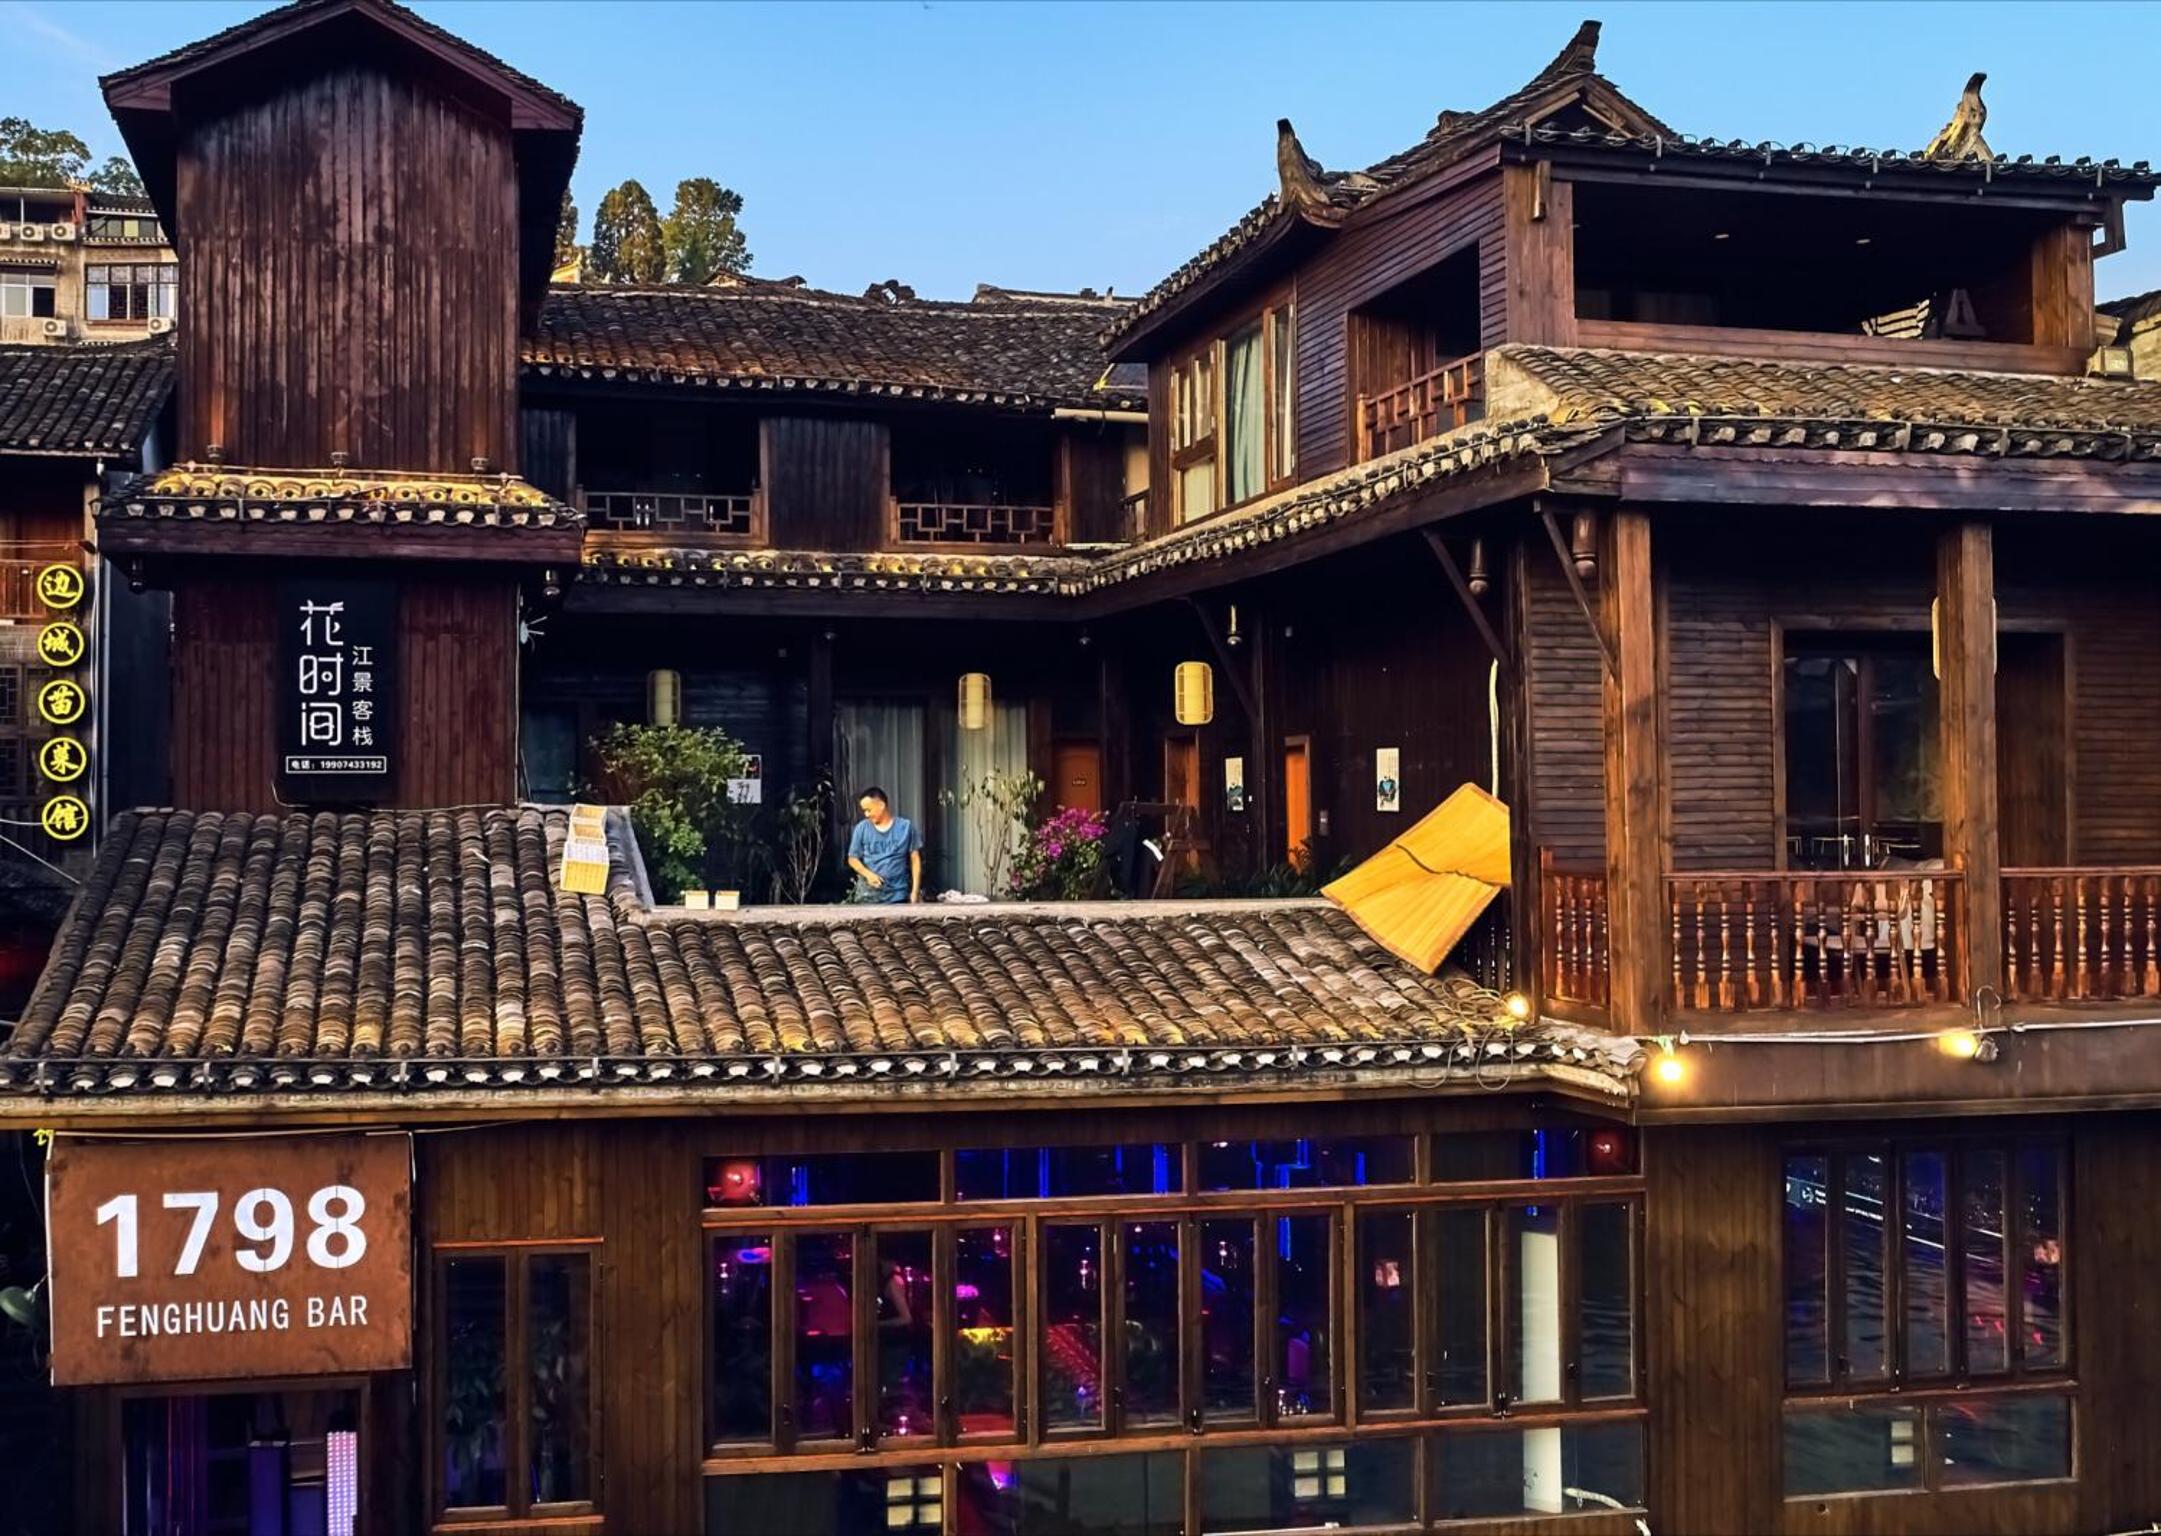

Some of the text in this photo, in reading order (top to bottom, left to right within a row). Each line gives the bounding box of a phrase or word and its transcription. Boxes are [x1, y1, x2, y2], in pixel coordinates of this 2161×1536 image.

[45, 570, 79, 832] 边城苗菜馆
[300, 600, 344, 746] 花时间
[352, 646, 373, 746] 江景客栈
[96, 1185, 367, 1278] 1798
[97, 1295, 368, 1338] FENGHUANG BAR
